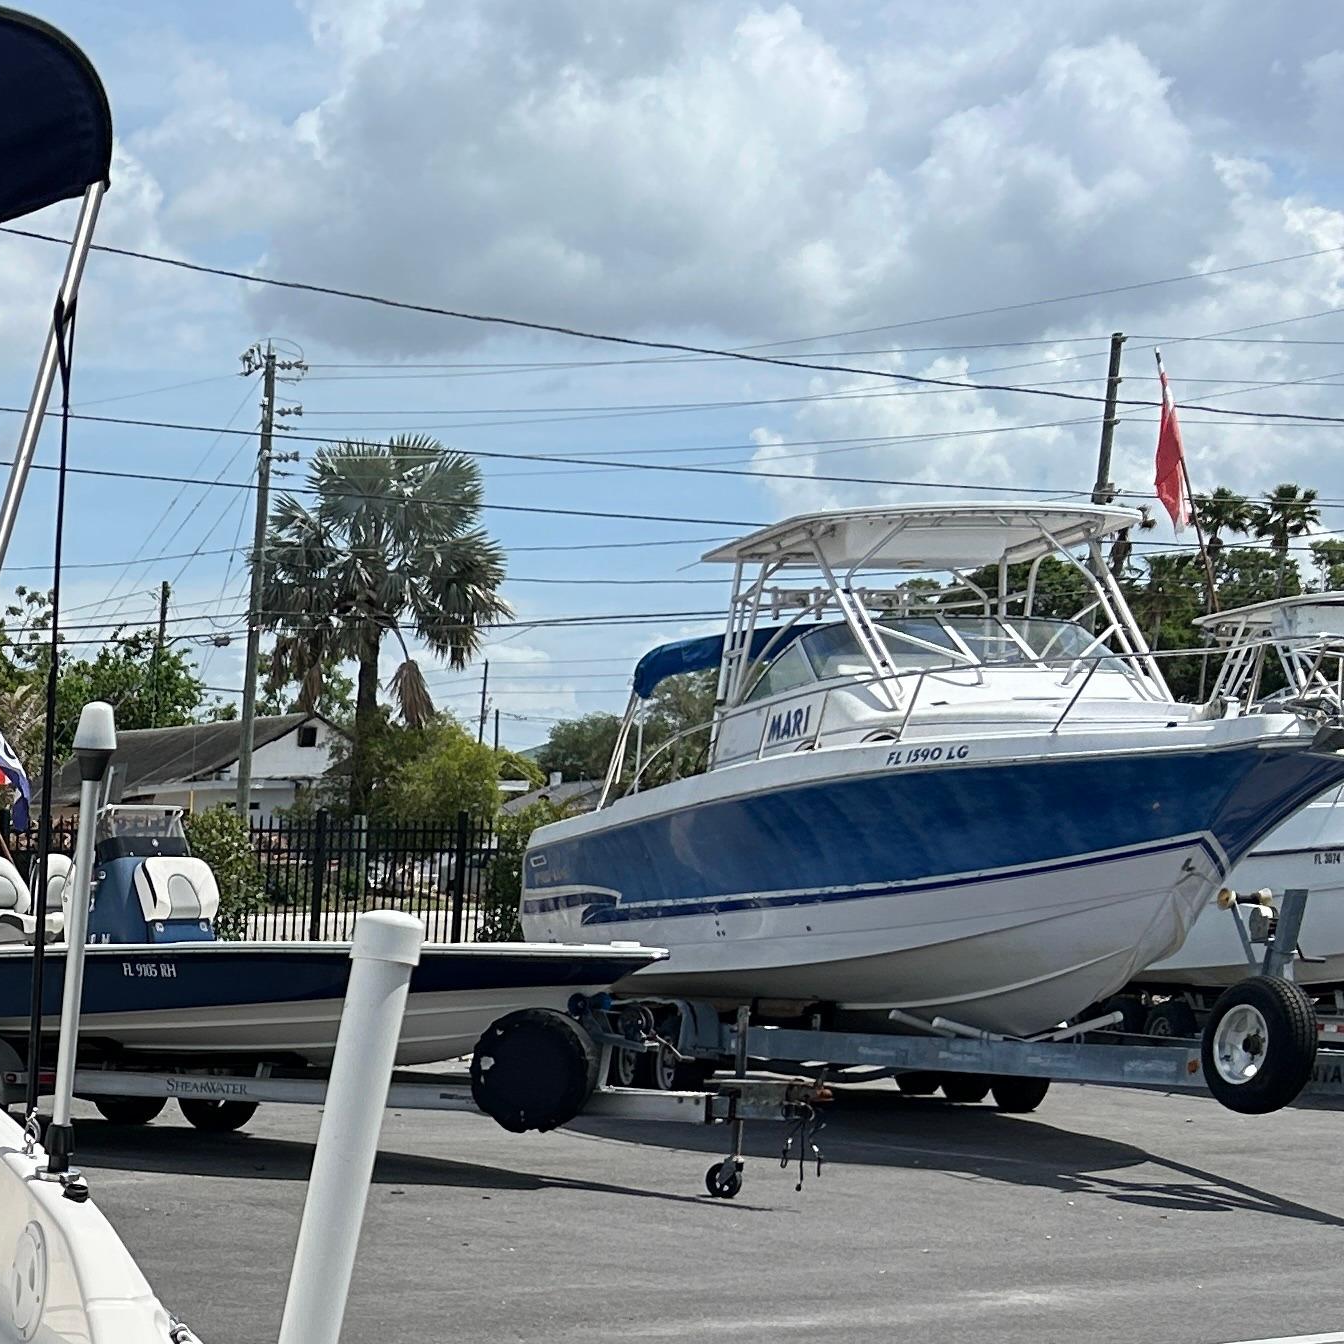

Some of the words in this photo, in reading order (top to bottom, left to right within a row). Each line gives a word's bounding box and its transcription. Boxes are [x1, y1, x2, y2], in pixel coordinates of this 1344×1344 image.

[767, 704, 812, 743] MARI
[886, 751, 902, 766] FL
[906, 747, 943, 765] 1590
[945, 745, 969, 761] LG
[1313, 853, 1323, 864] FL
[122, 962, 134, 976] FL
[135, 963, 158, 977] 9105
[159, 963, 177, 978] RH
